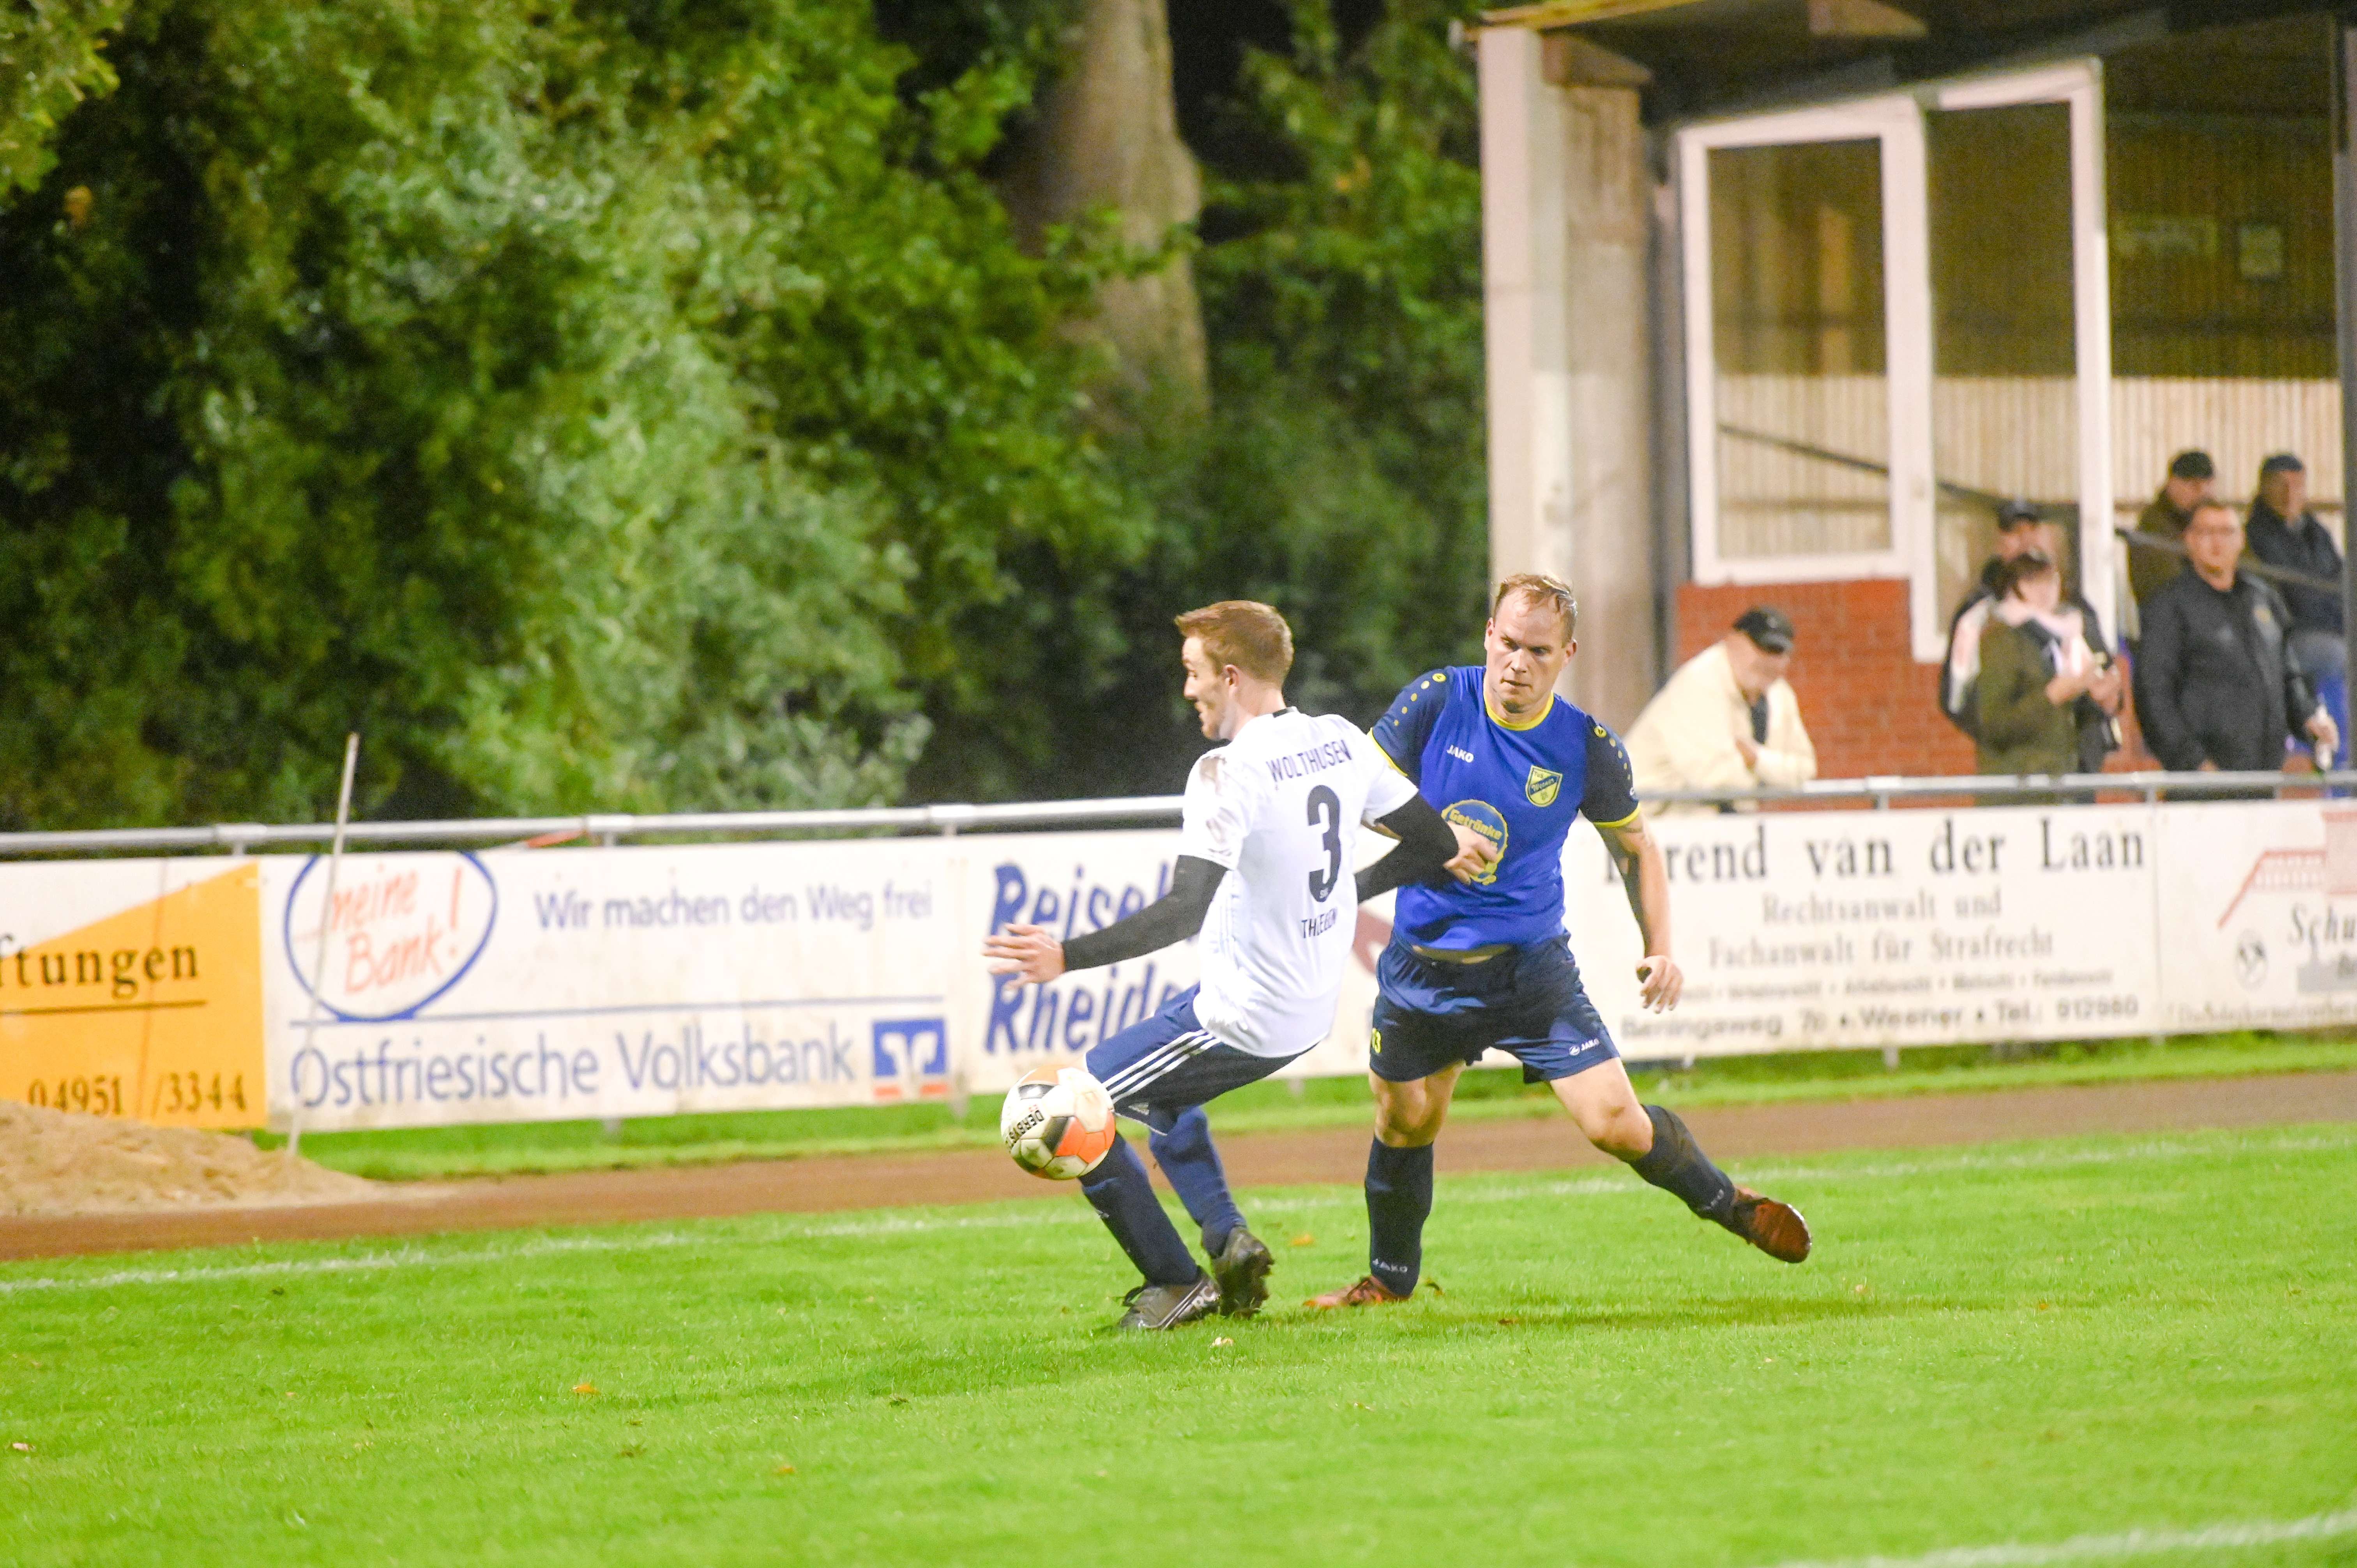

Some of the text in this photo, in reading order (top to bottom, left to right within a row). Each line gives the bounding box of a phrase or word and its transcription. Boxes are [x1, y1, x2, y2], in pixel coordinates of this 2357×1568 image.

[1446, 745, 1474, 763] JAKO
[1307, 784, 1341, 902] 3
[1806, 835, 1893, 878] van
[1929, 818, 2005, 875] der
[2040, 817, 2145, 872] Laan
[534, 879, 932, 932] Wir machen den Weg frei
[1762, 885, 2002, 926] Rechtsanwalt und
[1709, 923, 2053, 969] Fachanwalt für Strafrecht
[290, 1021, 855, 1109] Ostfriesische Volksbank
[1581, 1038, 1600, 1051] JAKO
[27, 1074, 123, 1116] 04951
[1372, 1258, 1408, 1273] JAKO
